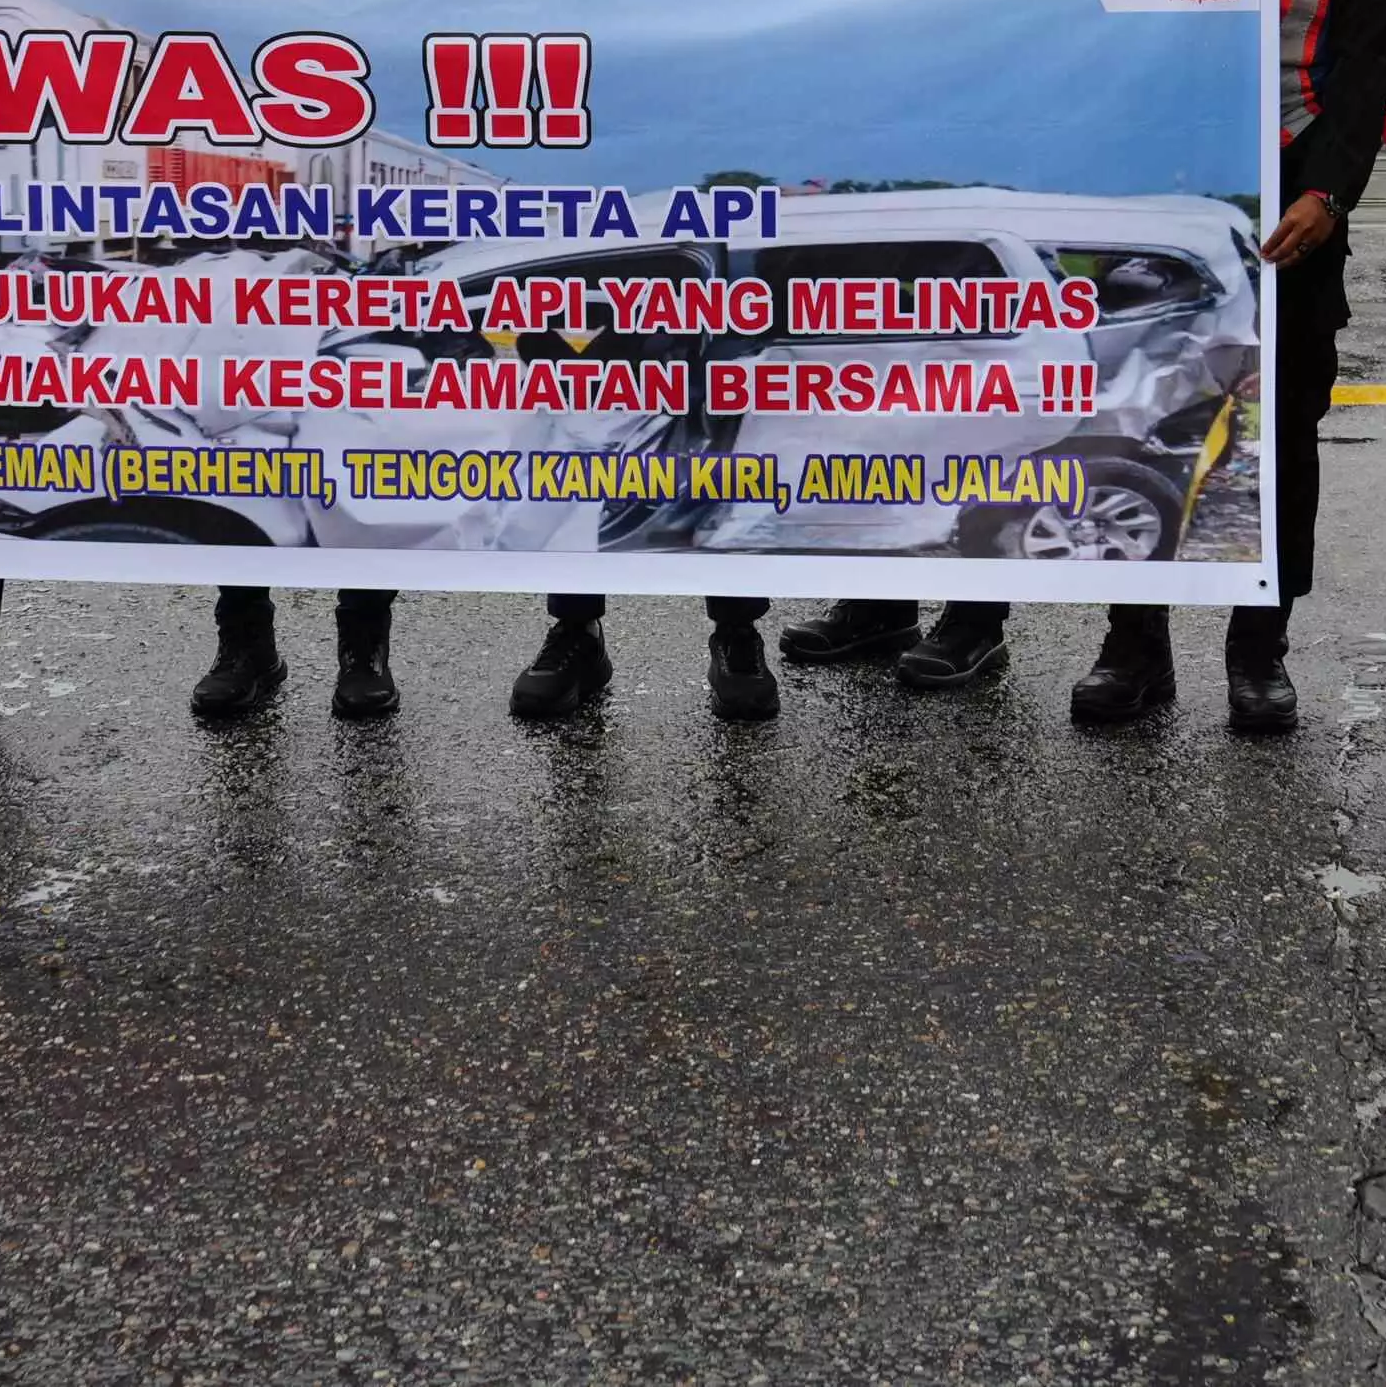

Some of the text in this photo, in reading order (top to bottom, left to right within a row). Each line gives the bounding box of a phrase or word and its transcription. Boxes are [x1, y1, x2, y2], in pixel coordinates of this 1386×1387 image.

[428, 36, 588, 145] !!!
[358, 187, 641, 239] KERETA
[660, 188, 778, 239] API
[234, 276, 471, 329] KERETA
[484, 279, 583, 331] API
[603, 279, 771, 332] YANG
[791, 279, 1098, 331] MELINTAS
[222, 357, 688, 413] KESELAMATAN
[707, 363, 1021, 413] BERSAMA
[1041, 363, 1095, 413] !!!
[104, 447, 336, 506] (BERHENTI,
[345, 452, 519, 499] TENGOK
[531, 454, 678, 500] KANAN
[690, 455, 790, 509] KIRI,
[801, 456, 923, 502] AMAN
[935, 456, 1087, 514] JALAN)
